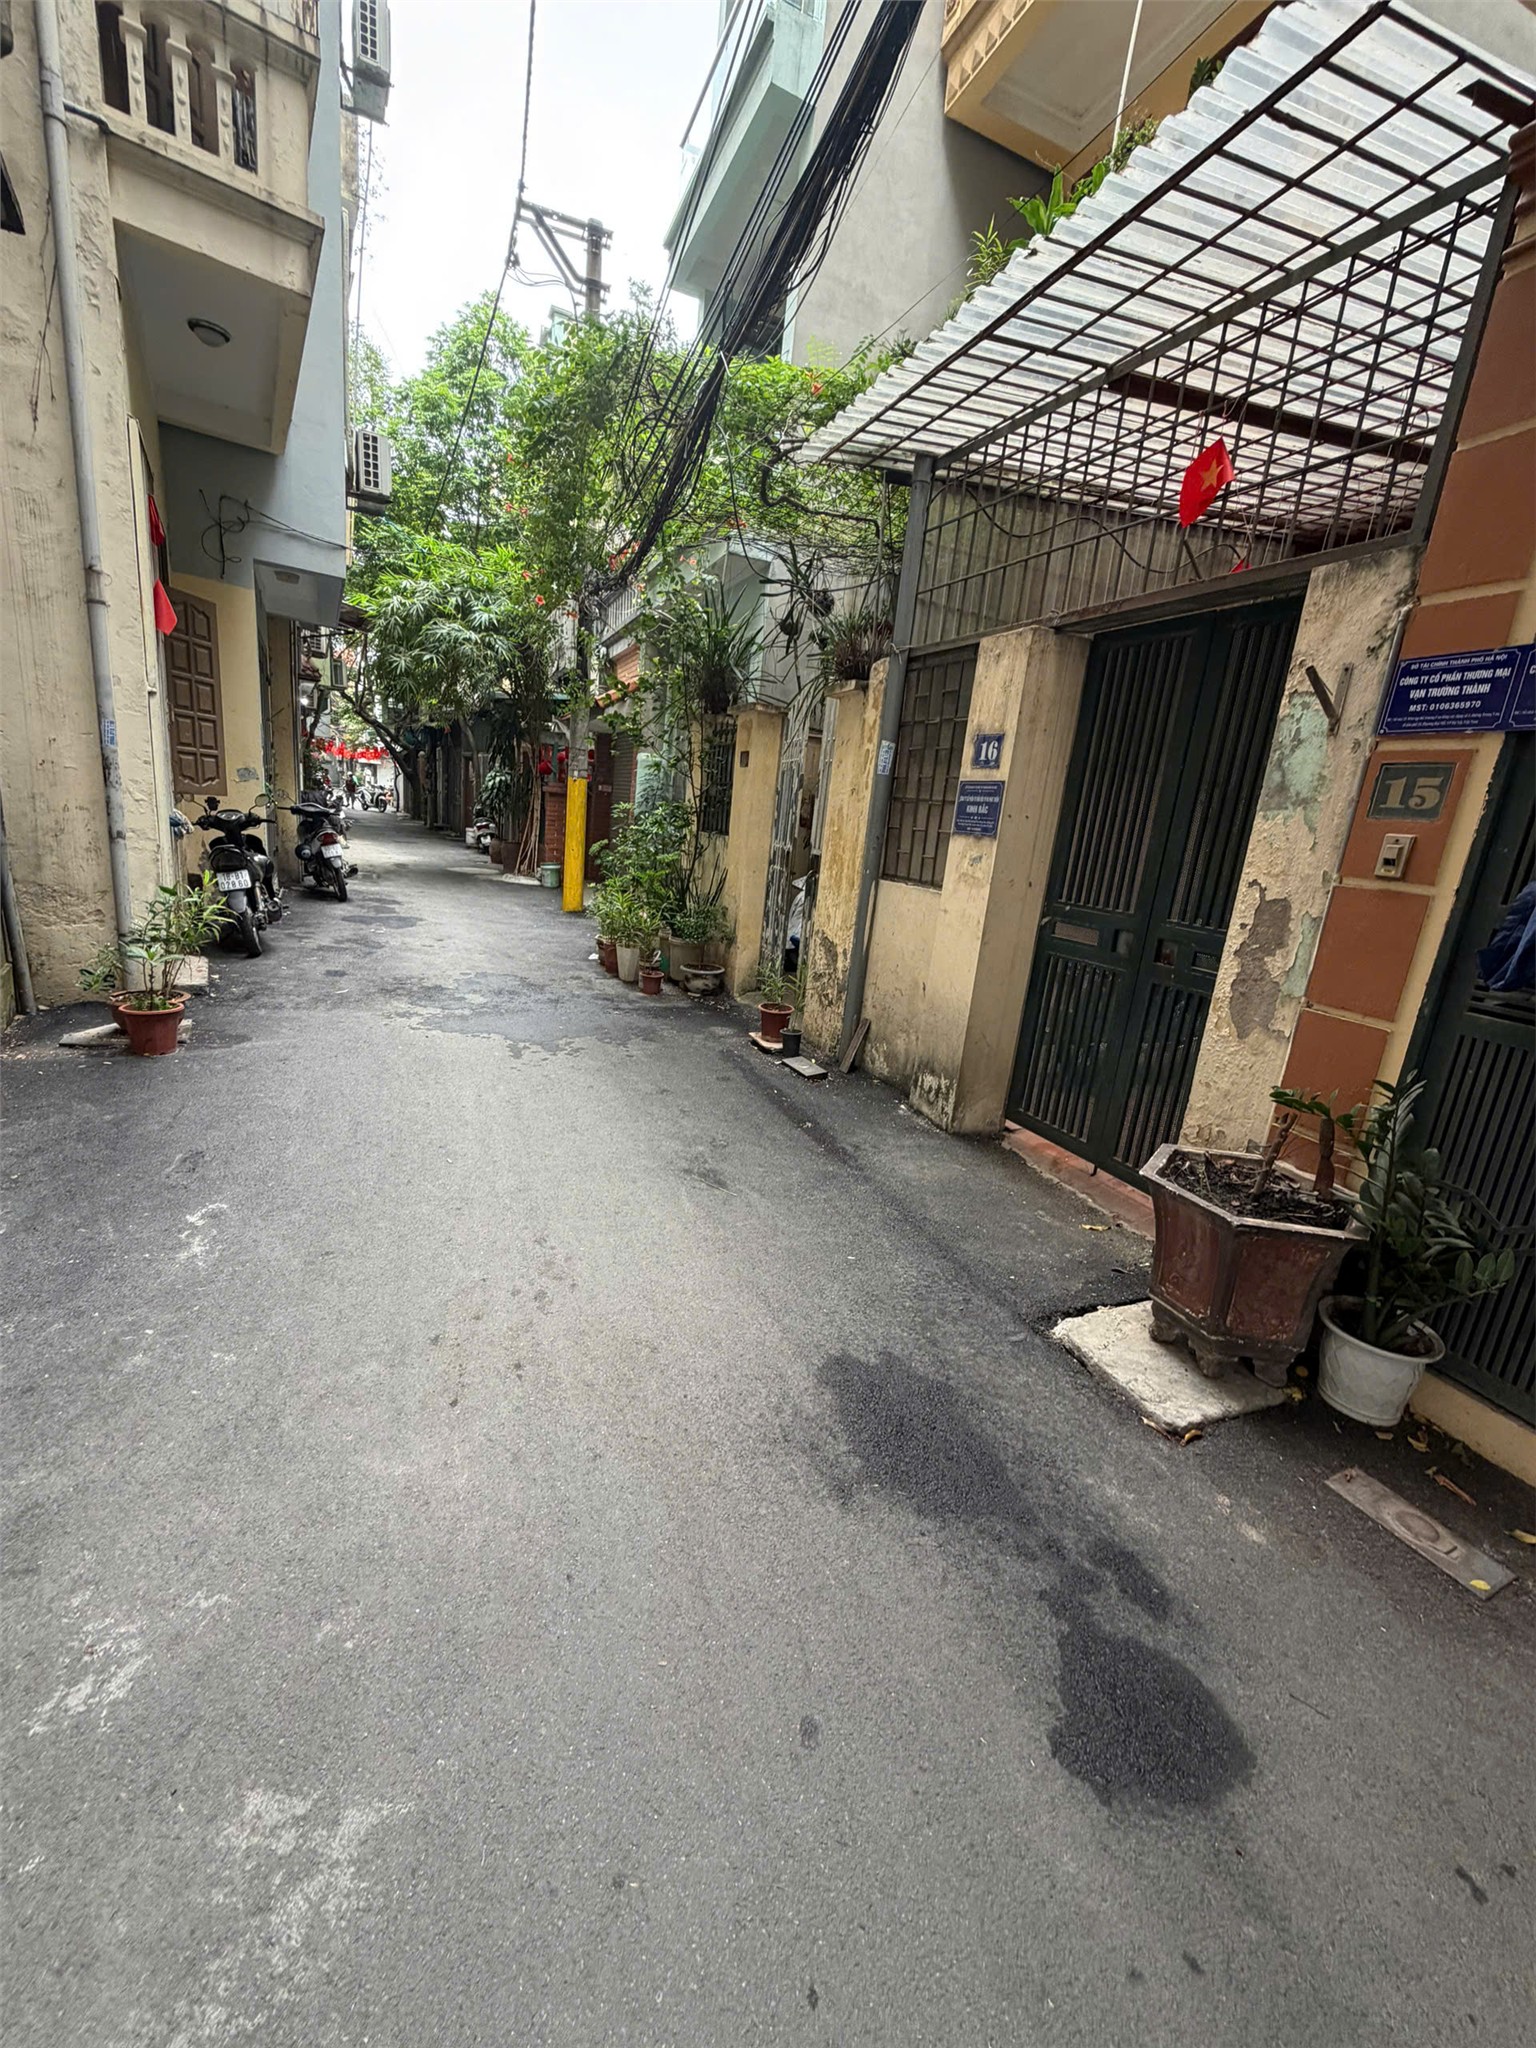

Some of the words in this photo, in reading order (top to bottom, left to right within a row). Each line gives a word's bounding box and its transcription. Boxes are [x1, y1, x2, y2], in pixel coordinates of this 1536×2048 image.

[1399, 676, 1419, 686] CÔNG
[1420, 675, 1429, 685] TY
[1463, 668, 1493, 681] THƯƠNG
[1494, 667, 1512, 679] MẠI
[1461, 683, 1491, 696] THÀNH
[1408, 703, 1428, 712] MST:
[979, 740, 999, 761] 16
[1380, 776, 1444, 810] 15
